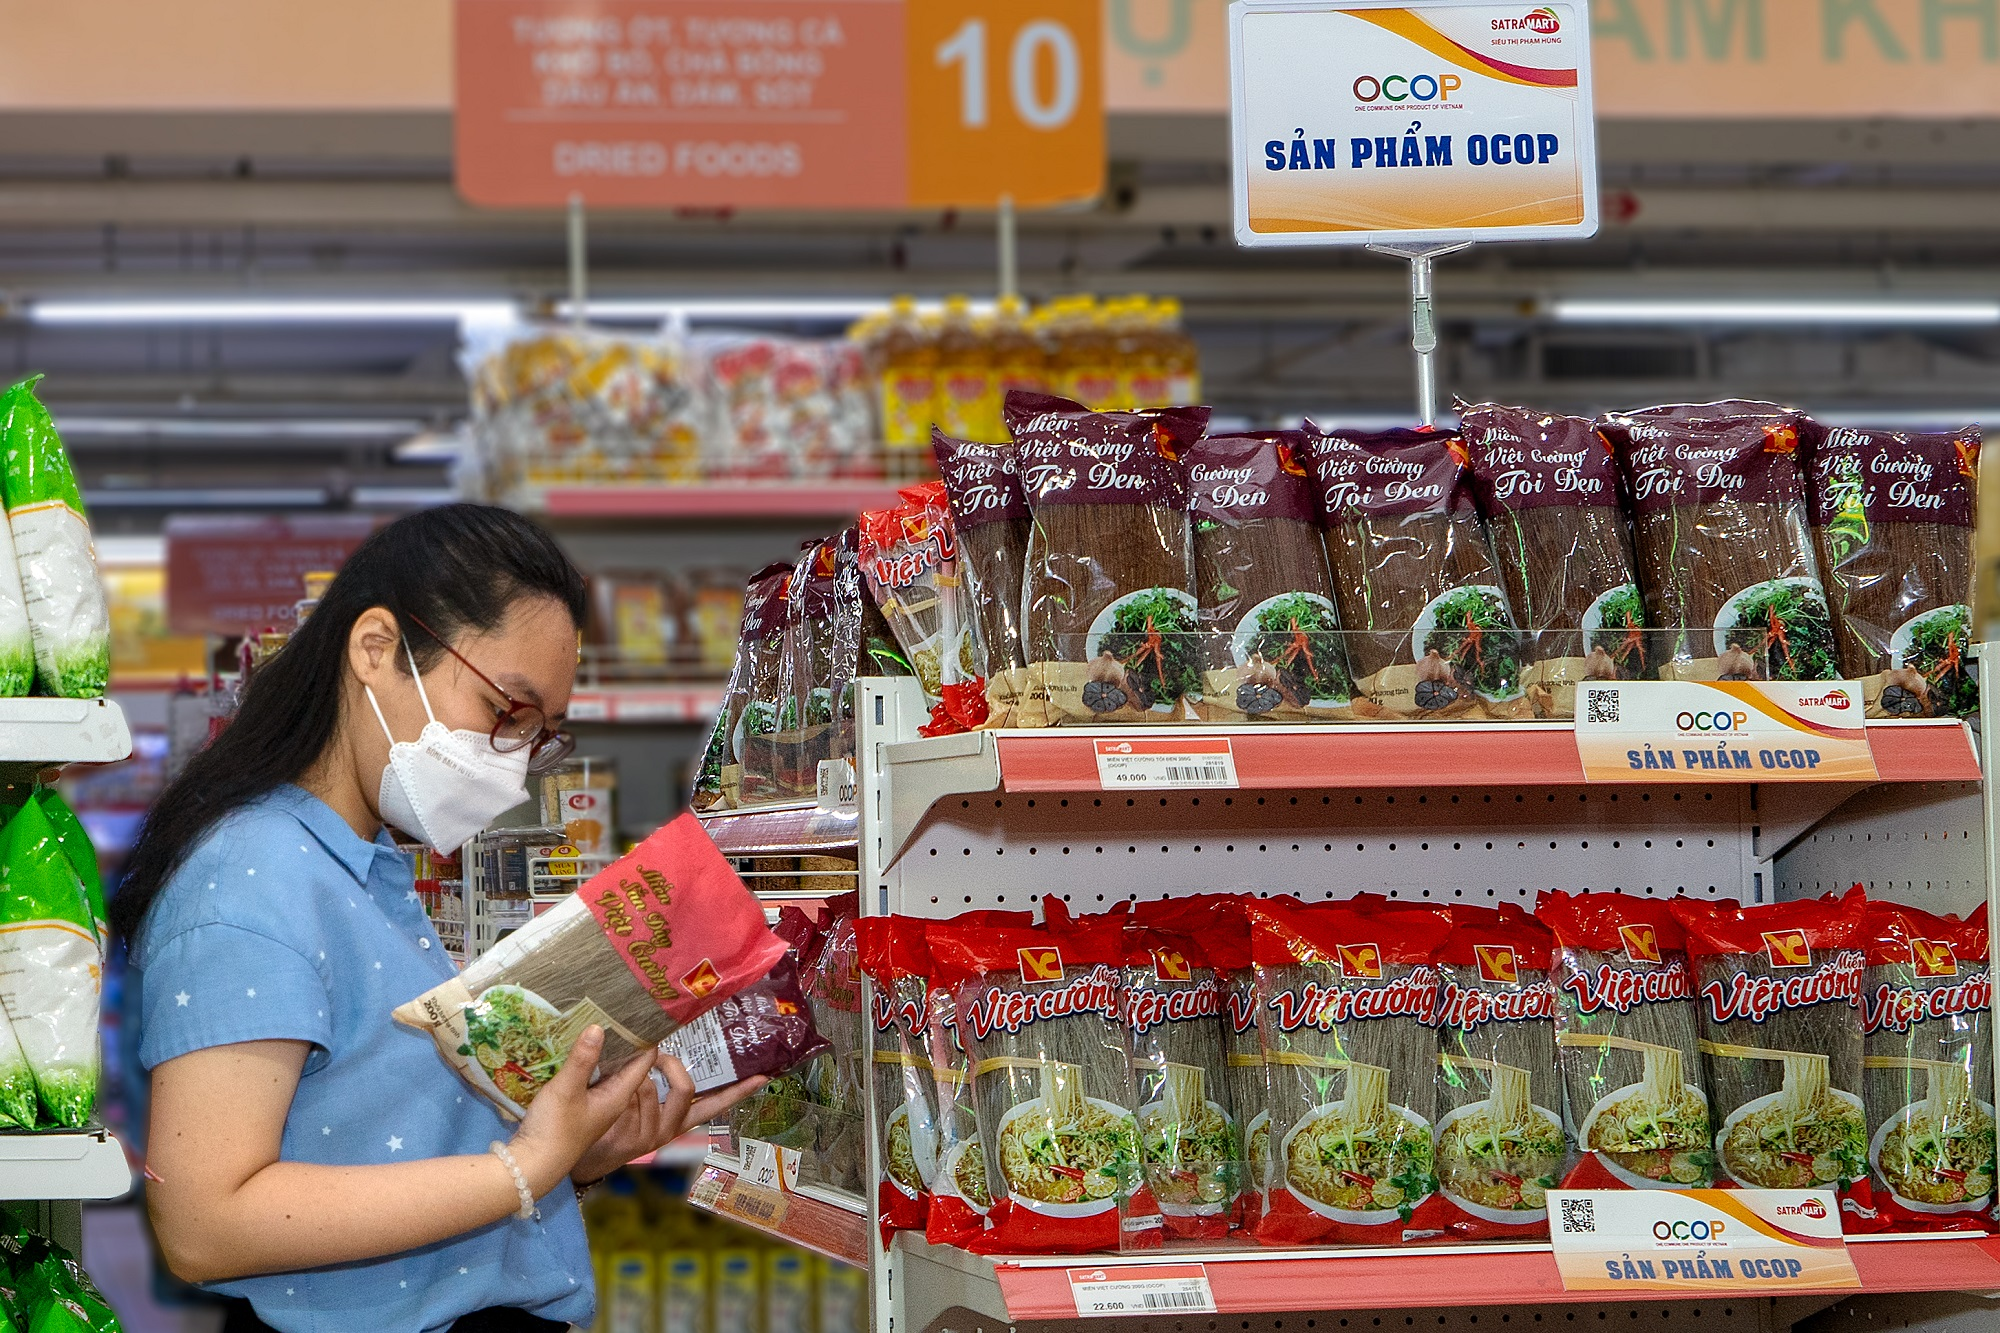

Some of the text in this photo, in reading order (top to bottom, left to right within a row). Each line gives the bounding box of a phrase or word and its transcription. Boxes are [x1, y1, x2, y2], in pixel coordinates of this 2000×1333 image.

[935, 18, 1083, 130] 10
[1353, 74, 1461, 102] OCOP
[553, 140, 803, 177] DRIED FOODS
[1265, 120, 1559, 171] SẢN PHẨM OCOP
[1019, 438, 1063, 464] Việt
[1484, 448, 1525, 469] Việt
[1630, 444, 1669, 468] Việt
[953, 462, 995, 485] Việt
[1087, 461, 1145, 490] Đen
[1316, 455, 1426, 483] Việt Cường
[1634, 462, 1746, 500] Tỏi Đen
[1870, 453, 1935, 482] Cường
[1325, 480, 1444, 513] Tỏi Đen
[1495, 466, 1603, 499] Tỏi Đen
[1887, 480, 1945, 511] Đen
[1212, 484, 1271, 510] Đen
[1676, 711, 1747, 731] OCOP
[1626, 741, 1821, 770] SẢN PHẨM OCOP
[1116, 773, 1147, 781] 49.000
[594, 890, 679, 1001] Việt Cường
[422, 1000, 440, 1021] 200
[1653, 1220, 1725, 1240] OCOP
[1605, 1250, 1803, 1280] SẢN PHẨM OCOP
[1093, 1302, 1124, 1310] 22.600
